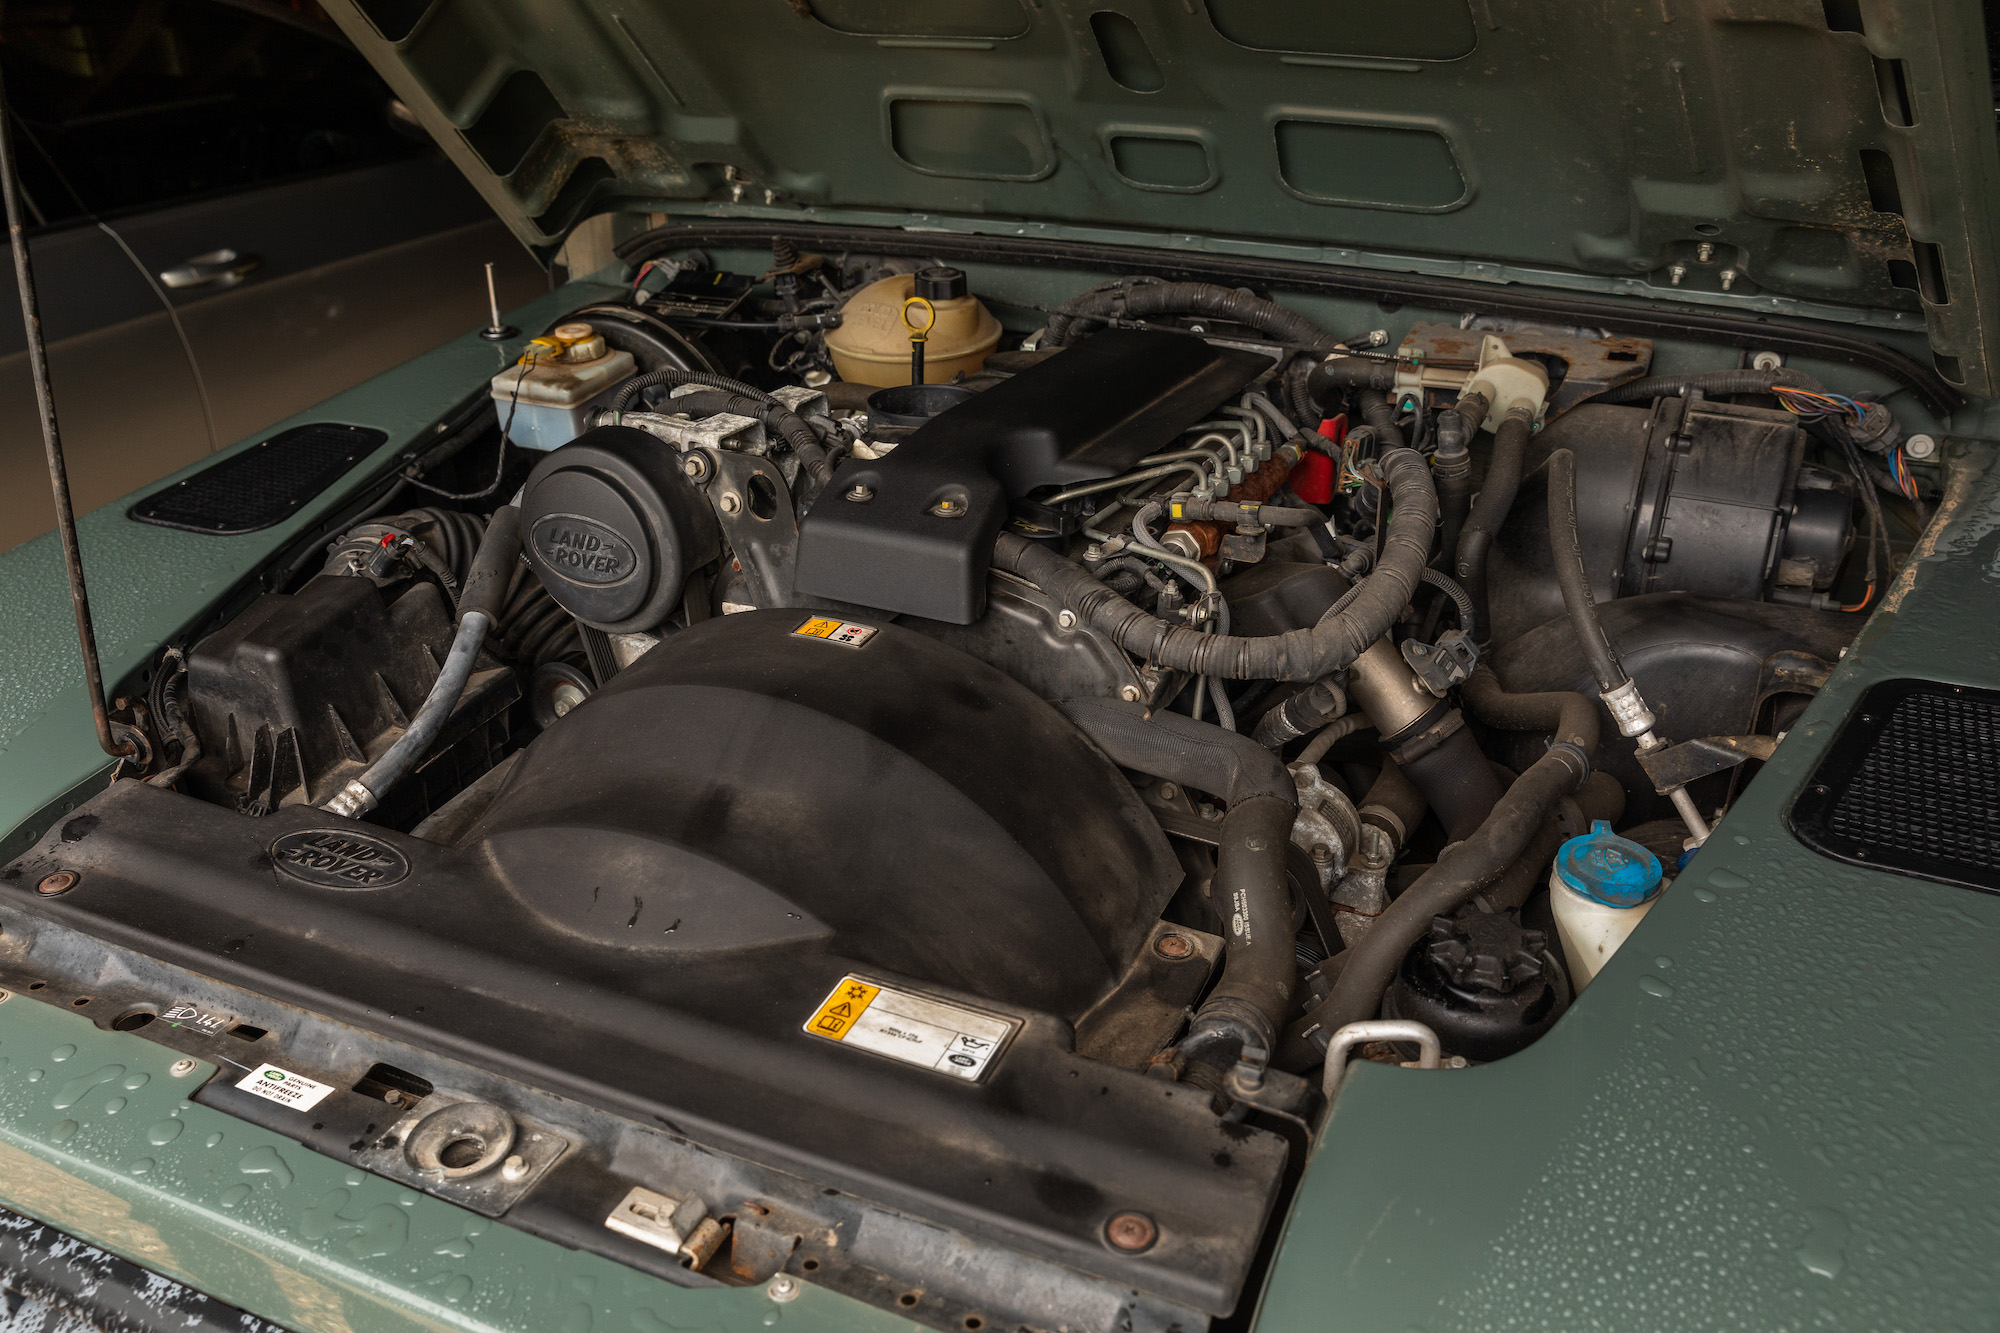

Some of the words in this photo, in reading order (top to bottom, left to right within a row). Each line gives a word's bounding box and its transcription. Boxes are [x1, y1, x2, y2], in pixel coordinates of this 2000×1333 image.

[550, 527, 600, 551] LAND
[555, 547, 620, 575] ROVER
[303, 834, 384, 861] LAND
[289, 850, 384, 884] ROVER
[1244, 921, 1252, 940] ISSUE
[256, 1079, 304, 1099] ANTIFREEZE
[282, 1081, 302, 1090] PARTS
[288, 1076, 317, 1090] GENUINE
[262, 1088, 275, 1096] NOT
[273, 1094, 292, 1103] DRAIN
